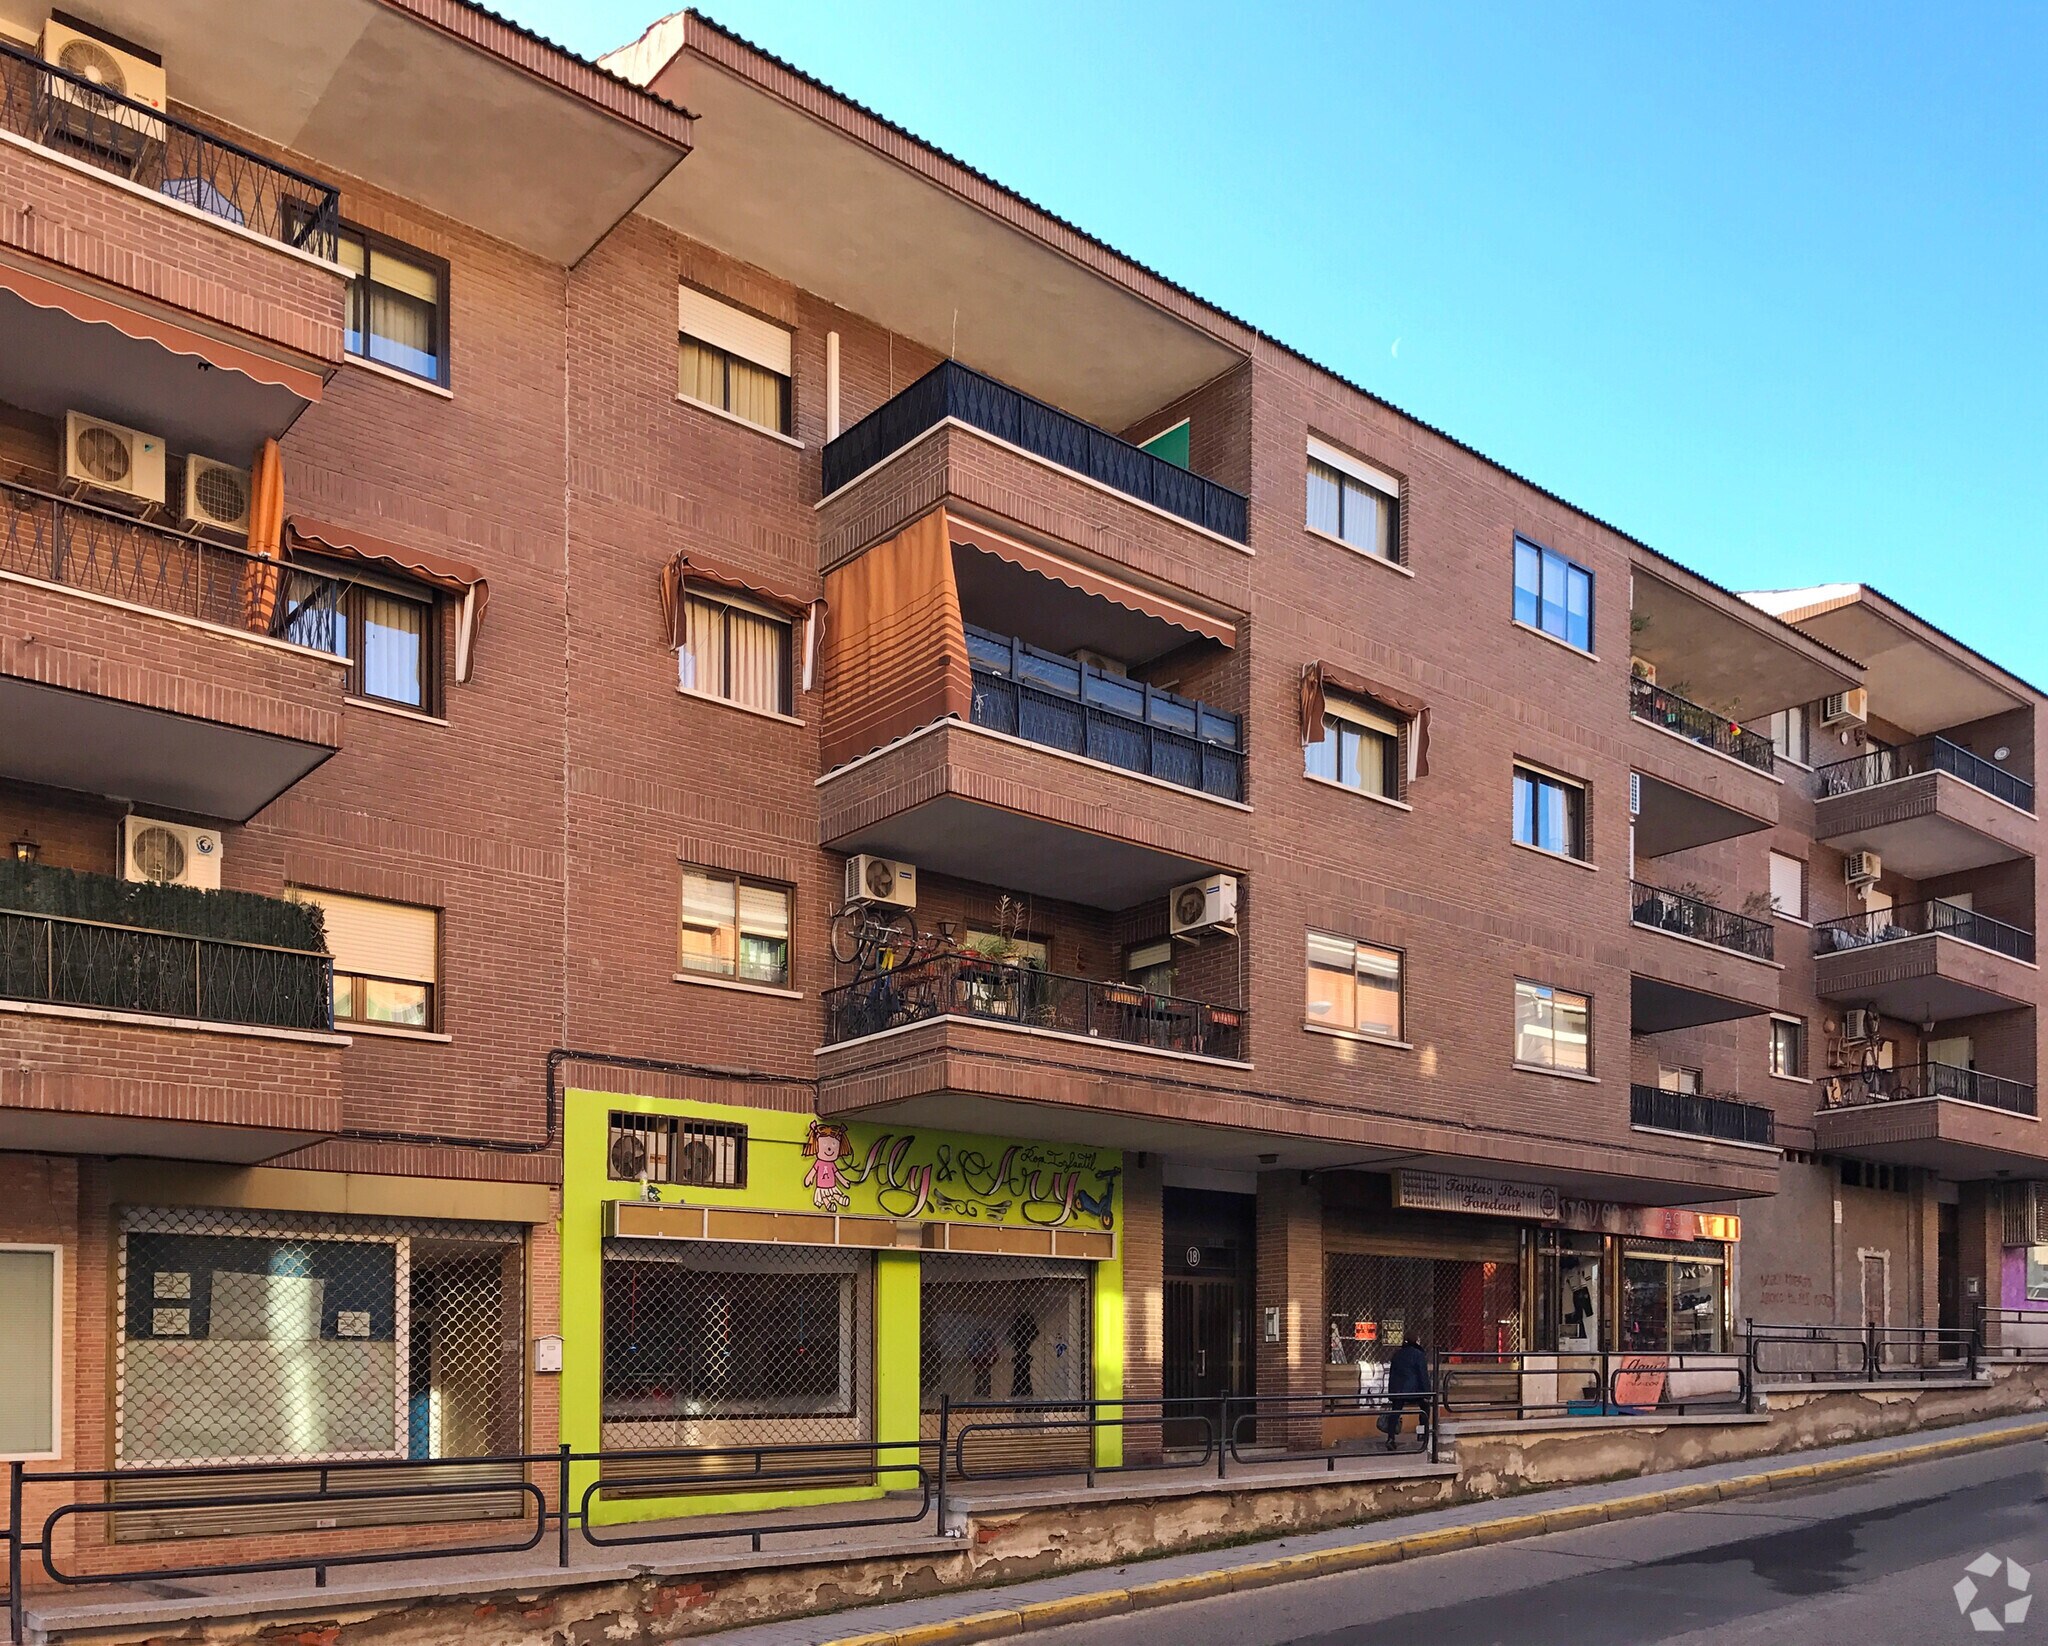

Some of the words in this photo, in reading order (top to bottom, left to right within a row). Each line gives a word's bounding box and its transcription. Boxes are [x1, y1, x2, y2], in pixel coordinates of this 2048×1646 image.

[935, 1144, 957, 1182] &
[958, 1145, 1080, 1226] Ary
[1445, 1178, 1493, 1195] Tartas
[1498, 1184, 1537, 1199] Rosa
[1462, 1195, 1522, 1212] Fondant
[1189, 1251, 1198, 1264] 18
